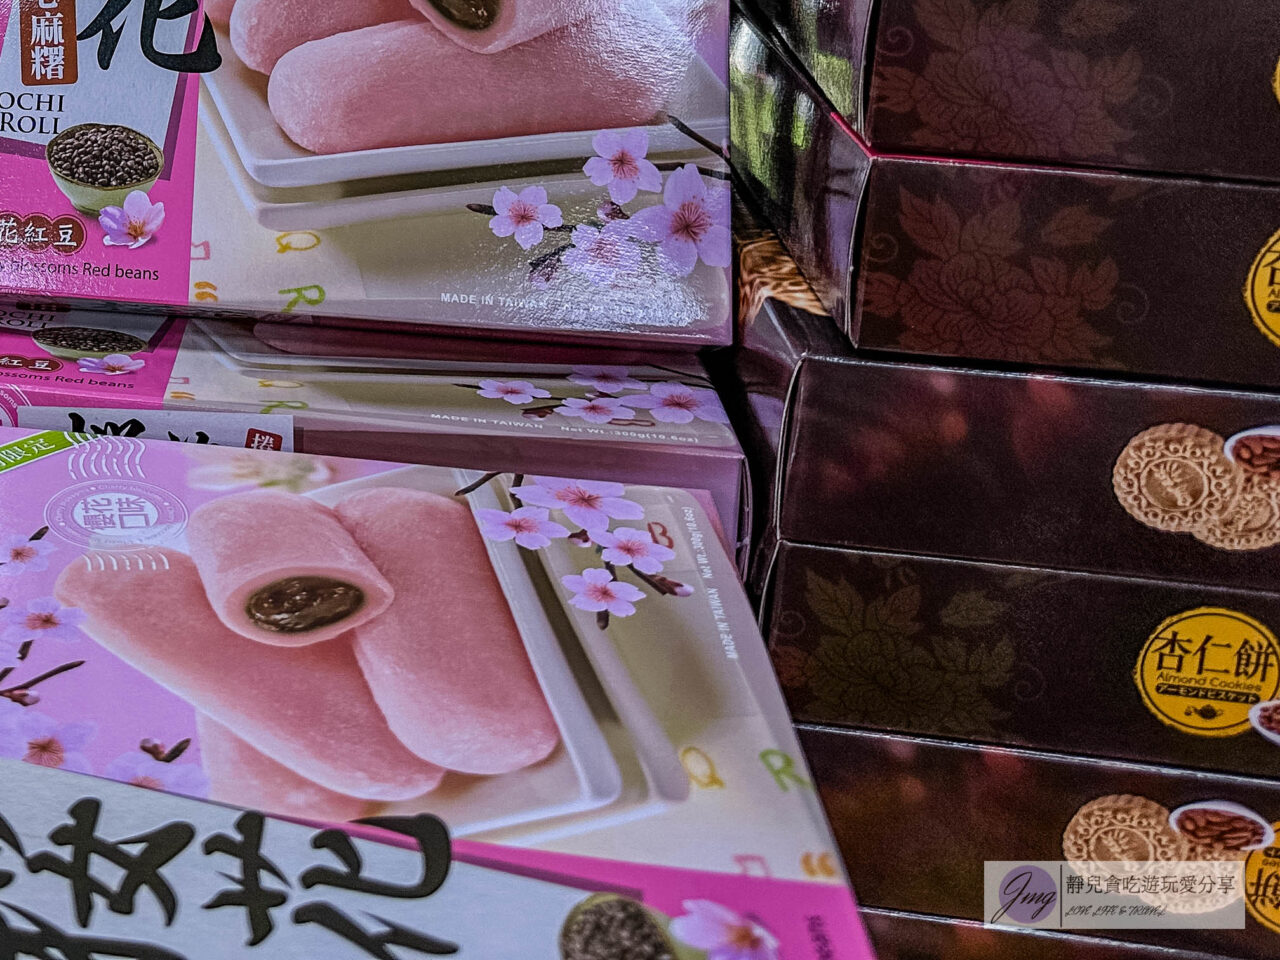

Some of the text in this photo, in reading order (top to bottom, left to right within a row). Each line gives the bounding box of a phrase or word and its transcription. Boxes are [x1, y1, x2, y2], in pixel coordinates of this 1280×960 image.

[0, 111, 61, 135] ROLL
[82, 262, 111, 278] Red
[115, 264, 160, 281] beans
[440, 292, 477, 305] MADE
[481, 295, 494, 306] IN
[54, 374, 84, 386] Red
[88, 377, 135, 390] beans
[431, 413, 469, 423] MADE
[492, 419, 544, 430] TAIWAN
[560, 425, 583, 434] Net
[707, 587, 724, 621] TAIWAN
[716, 622, 730, 634] IN
[720, 633, 738, 659] MADE
[1152, 630, 1275, 685] 杏仁餅
[1156, 671, 1262, 693] Almond Cookies
